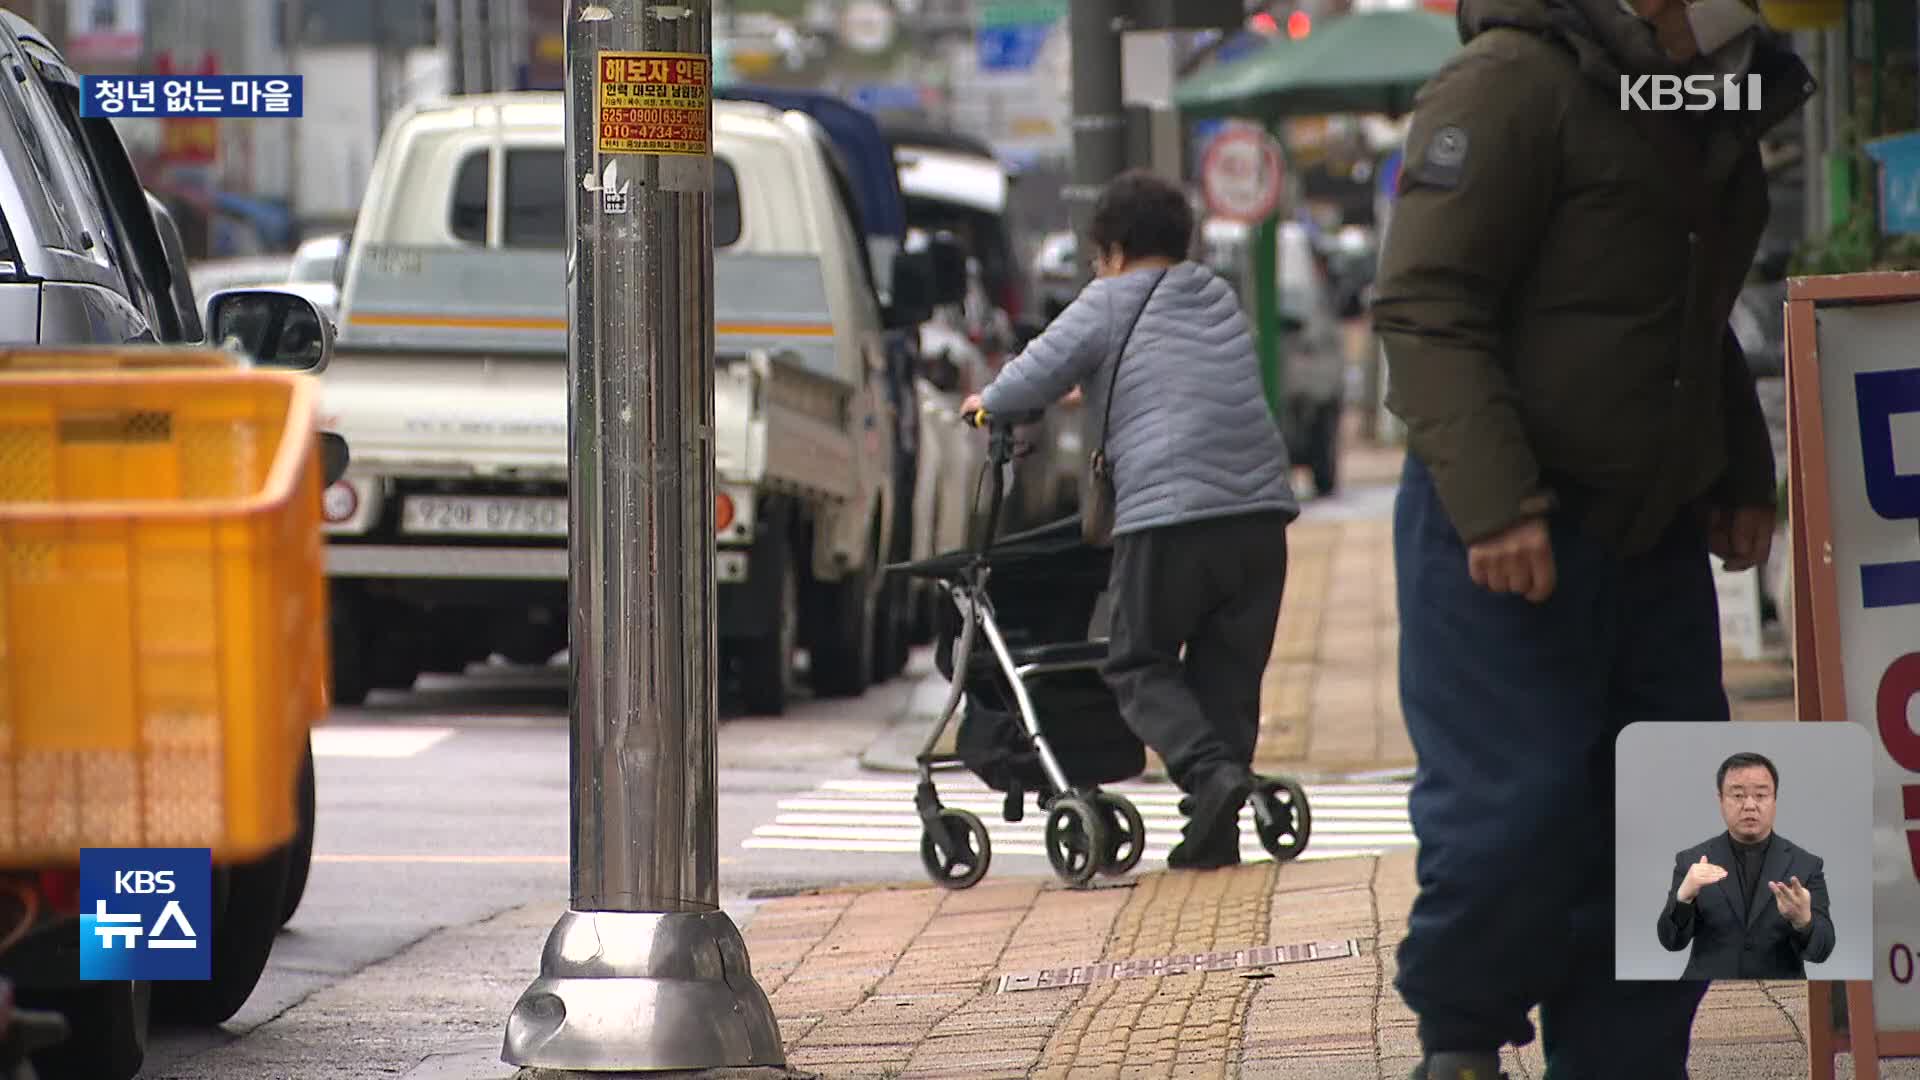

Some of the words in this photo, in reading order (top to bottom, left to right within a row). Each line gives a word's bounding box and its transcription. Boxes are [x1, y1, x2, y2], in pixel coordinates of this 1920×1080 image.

[606, 59, 668, 82] 해보자
[606, 84, 628, 96] 인력
[633, 84, 667, 97] 대모집
[602, 109, 658, 122] 625-0900
